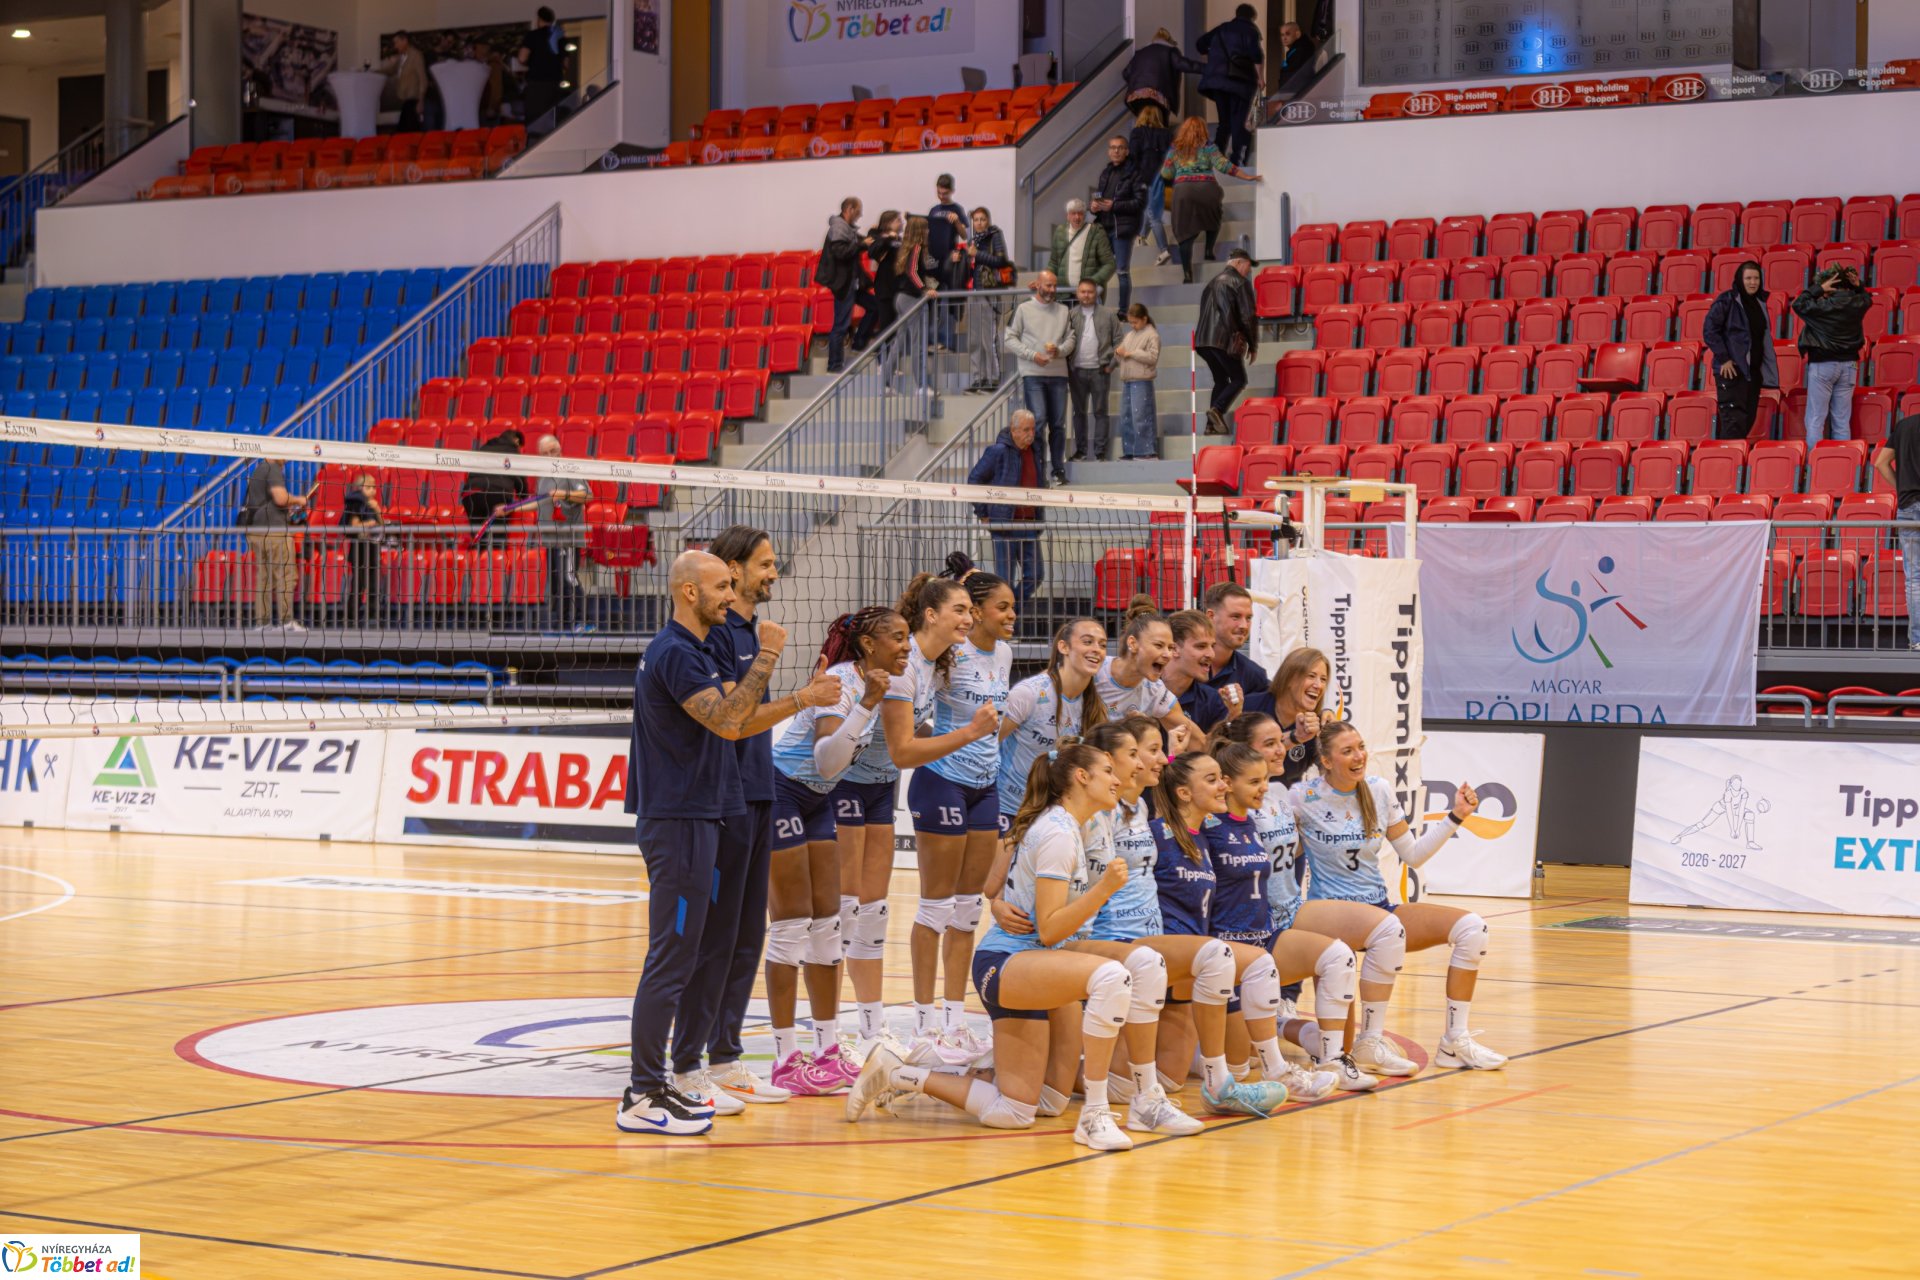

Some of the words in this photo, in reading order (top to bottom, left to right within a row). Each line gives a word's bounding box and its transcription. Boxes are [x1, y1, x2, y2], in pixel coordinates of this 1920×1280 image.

[836, 12, 911, 39] Többet
[915, 7, 952, 33] ad!
[1848, 68, 1868, 77] Bige
[1871, 66, 1905, 76] Holding
[1575, 85, 1594, 93] Bige
[1597, 84, 1629, 93] Holding
[1711, 77, 1730, 85] Bige
[1810, 73, 1835, 88] BH
[1858, 77, 1895, 87] Csoport
[1445, 92, 1463, 101] Bige
[1465, 90, 1497, 100] Holding
[1539, 89, 1564, 104] BH
[1673, 82, 1697, 96] BH
[1721, 86, 1755, 95] Csoport
[1409, 97, 1435, 112] BH
[1454, 102, 1487, 111] Csoport
[1585, 95, 1619, 103] Csoport
[1286, 103, 1311, 119] BH
[1531, 679, 1602, 694] MAGYAR
[173, 736, 309, 772] KE-VIZ
[313, 739, 360, 774] 21
[93, 790, 138, 804] KE-VIZ
[140, 792, 155, 805] 21
[241, 781, 280, 799] ZRT.
[837, 800, 862, 817] 21
[1839, 784, 1919, 828] Tipp
[938, 806, 964, 826] 15
[998, 814, 1010, 831] 9
[775, 816, 804, 839] 20
[1272, 842, 1296, 873] 23
[1346, 848, 1361, 871] 3
[1681, 852, 1709, 868] 2026
[1718, 854, 1747, 869] 2027
[1834, 836, 1920, 872] EXT
[1250, 870, 1261, 899] 1
[284, 1039, 632, 1075] NYÍREGYH
